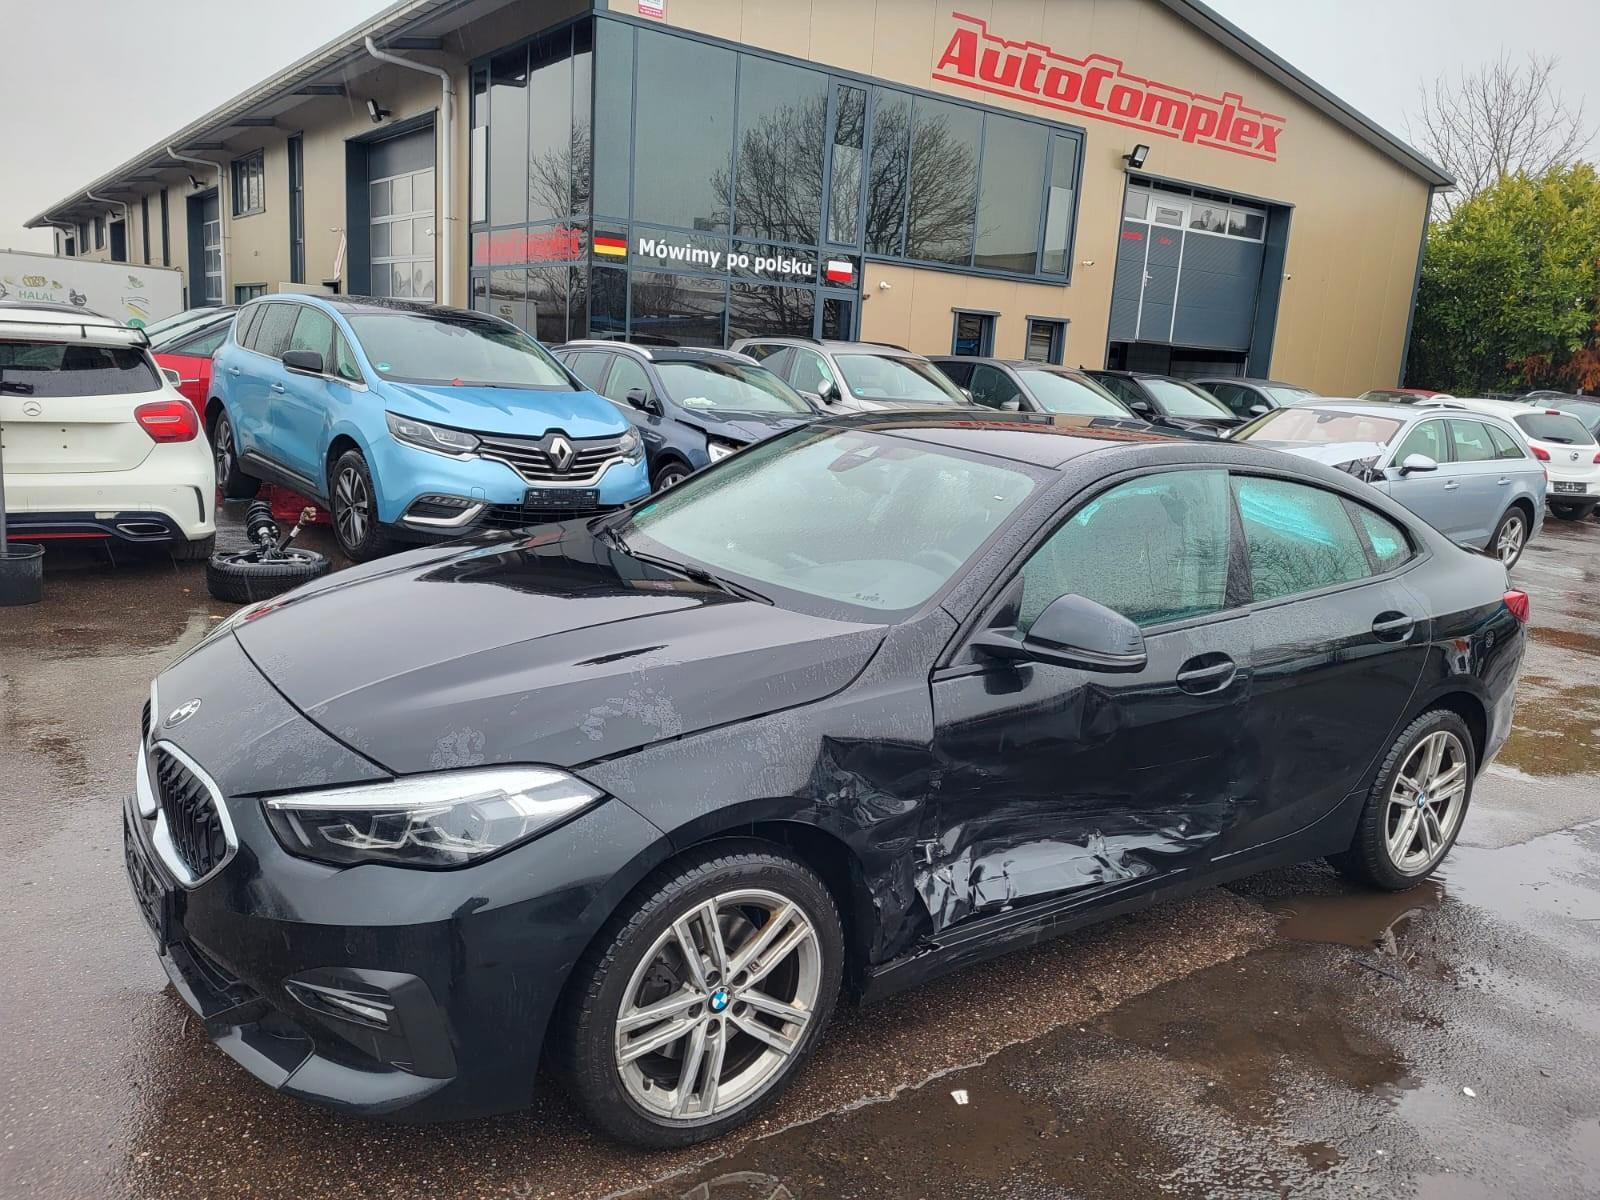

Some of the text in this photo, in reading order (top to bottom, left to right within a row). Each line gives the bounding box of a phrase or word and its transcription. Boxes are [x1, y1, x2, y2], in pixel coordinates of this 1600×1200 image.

[937, 28, 1284, 155] AutoComplex
[639, 238, 812, 276] Mówimy po polsku
[18, 290, 56, 302] HALAL
